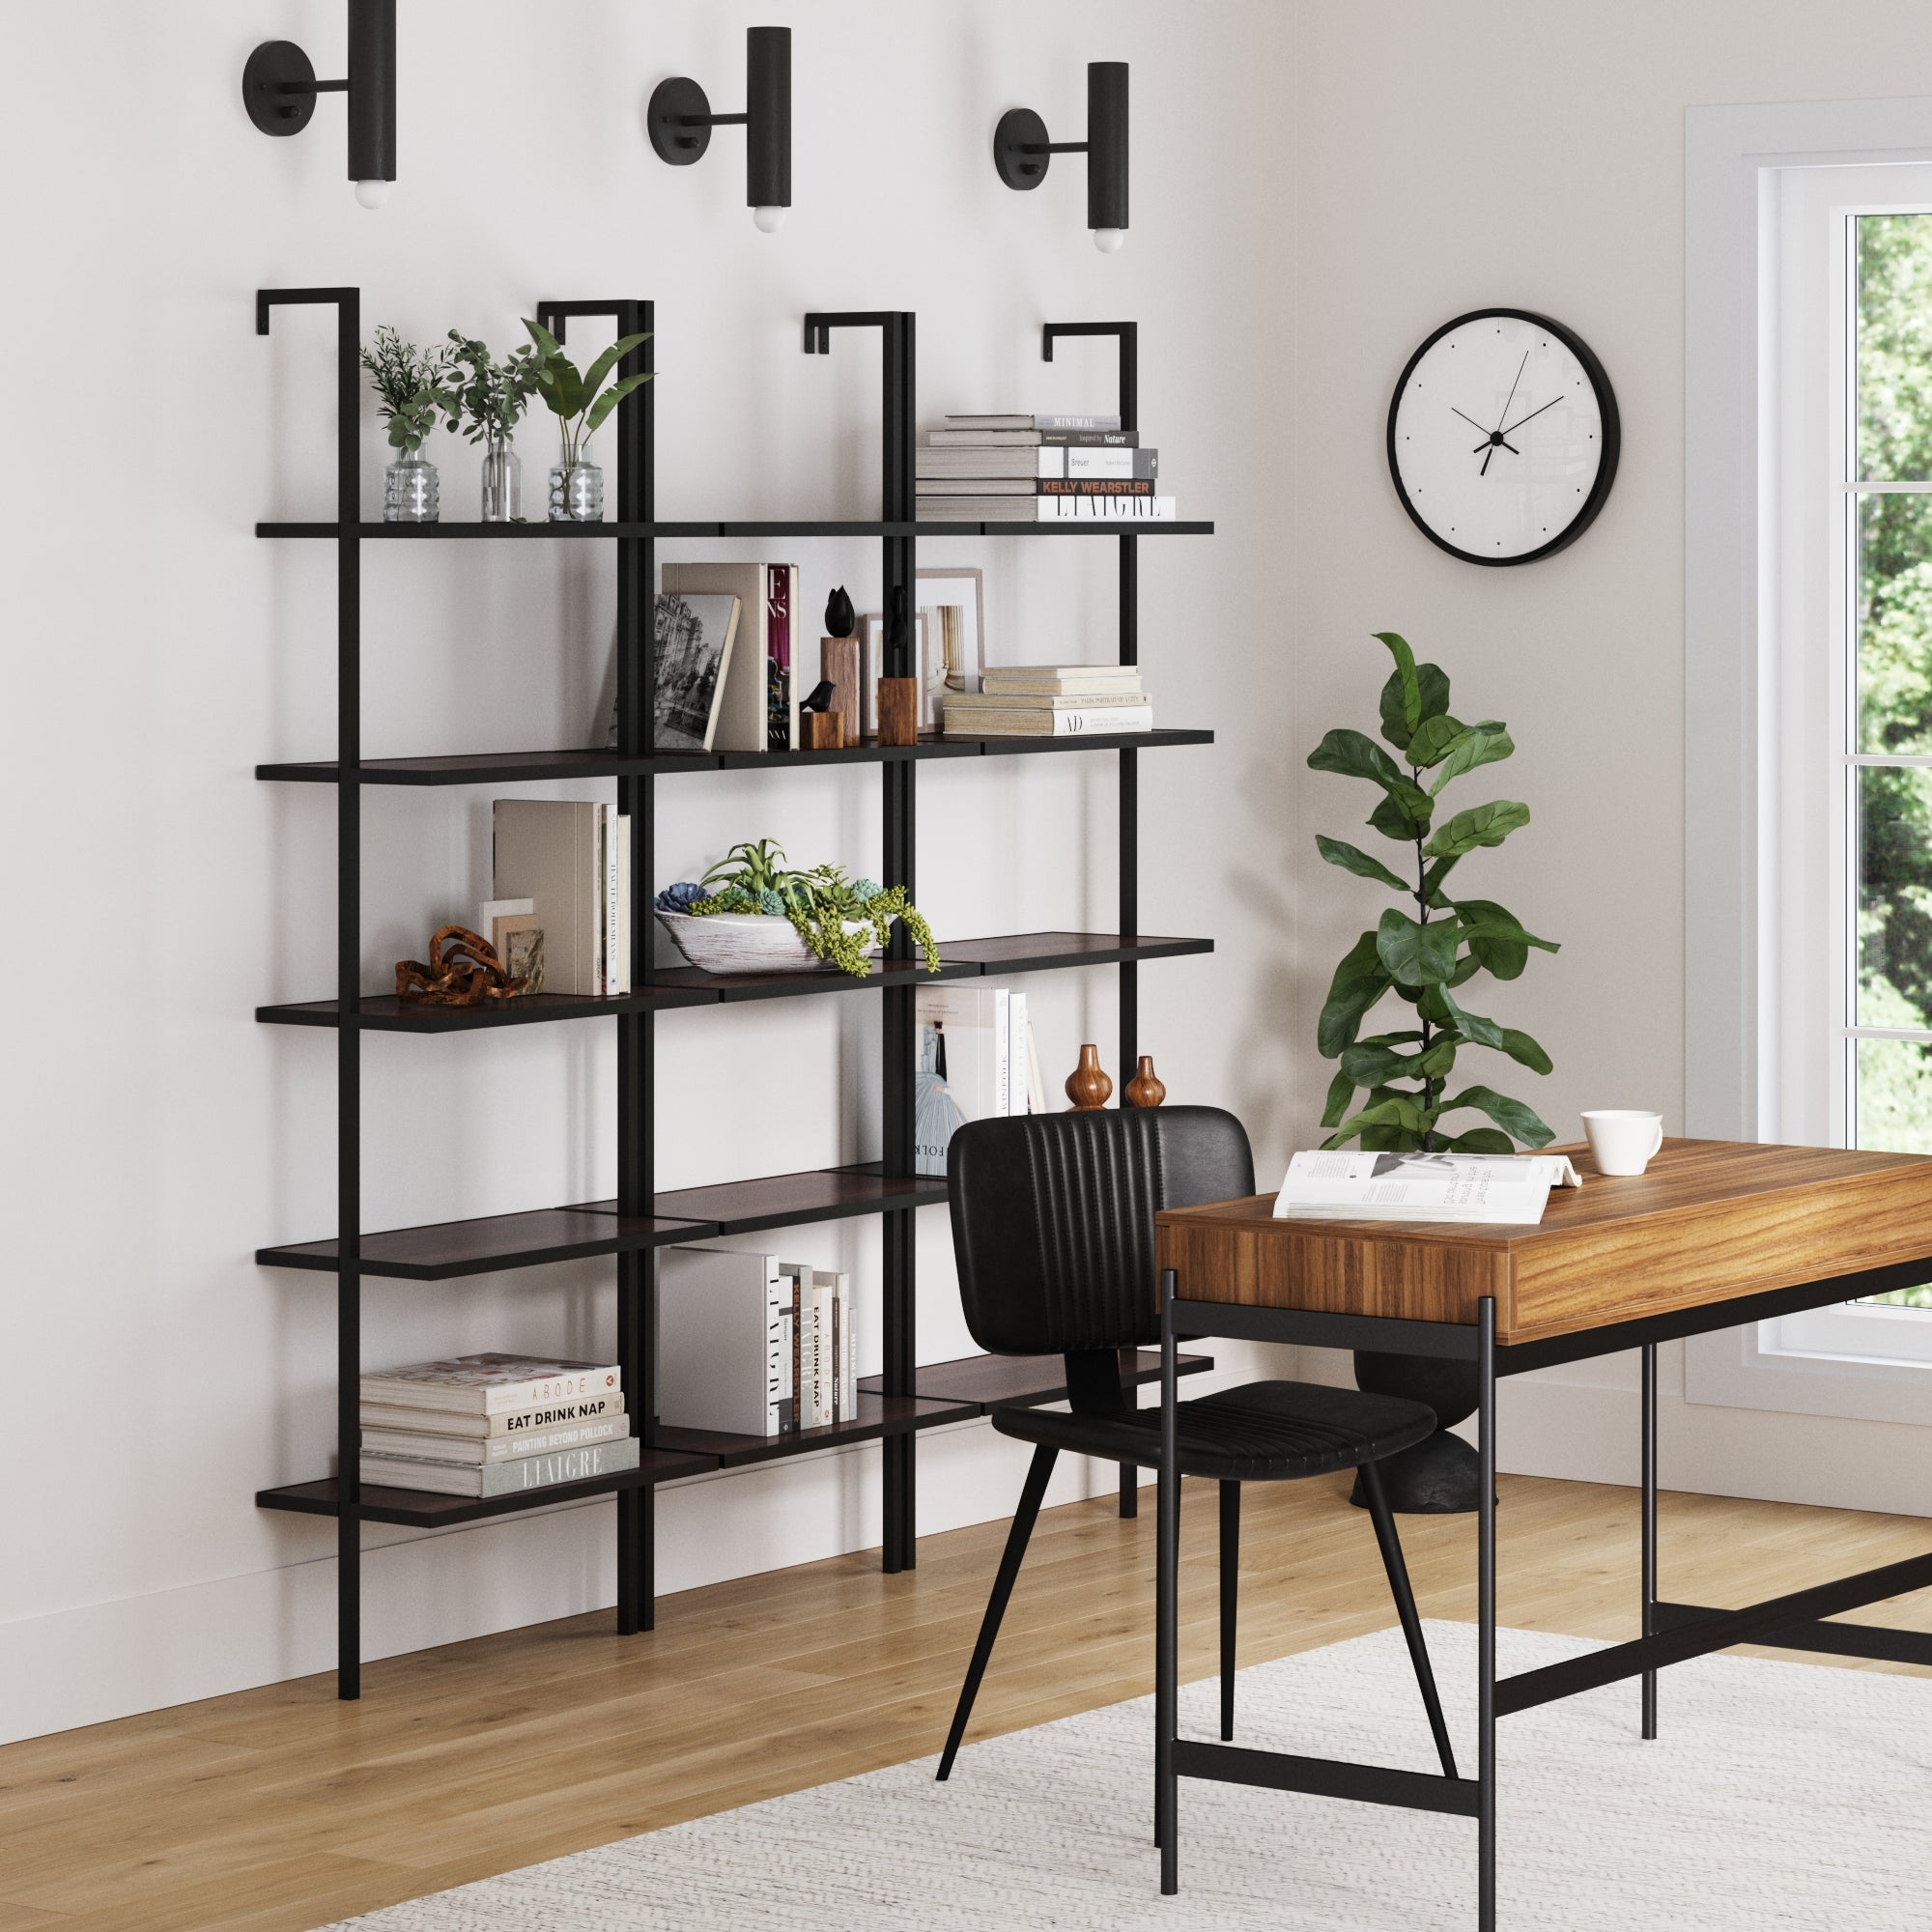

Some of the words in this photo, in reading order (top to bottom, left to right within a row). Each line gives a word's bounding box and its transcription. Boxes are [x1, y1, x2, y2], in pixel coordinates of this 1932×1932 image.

[1053, 416, 1095, 428] MINIMAL
[1103, 434, 1126, 444] Nature
[1042, 481, 1078, 494] KELLY
[1081, 481, 1150, 494] WEARSTLER
[532, 1377, 586, 1401] ABODE
[507, 1414, 530, 1431] EAT
[534, 1406, 576, 1426] DRINK
[579, 1401, 607, 1417] NAP
[512, 1435, 547, 1454] PAINTING
[549, 1429, 579, 1447] BEYOND
[580, 1422, 613, 1441] POLLOCK
[523, 1448, 603, 1488] LIAIGRE
